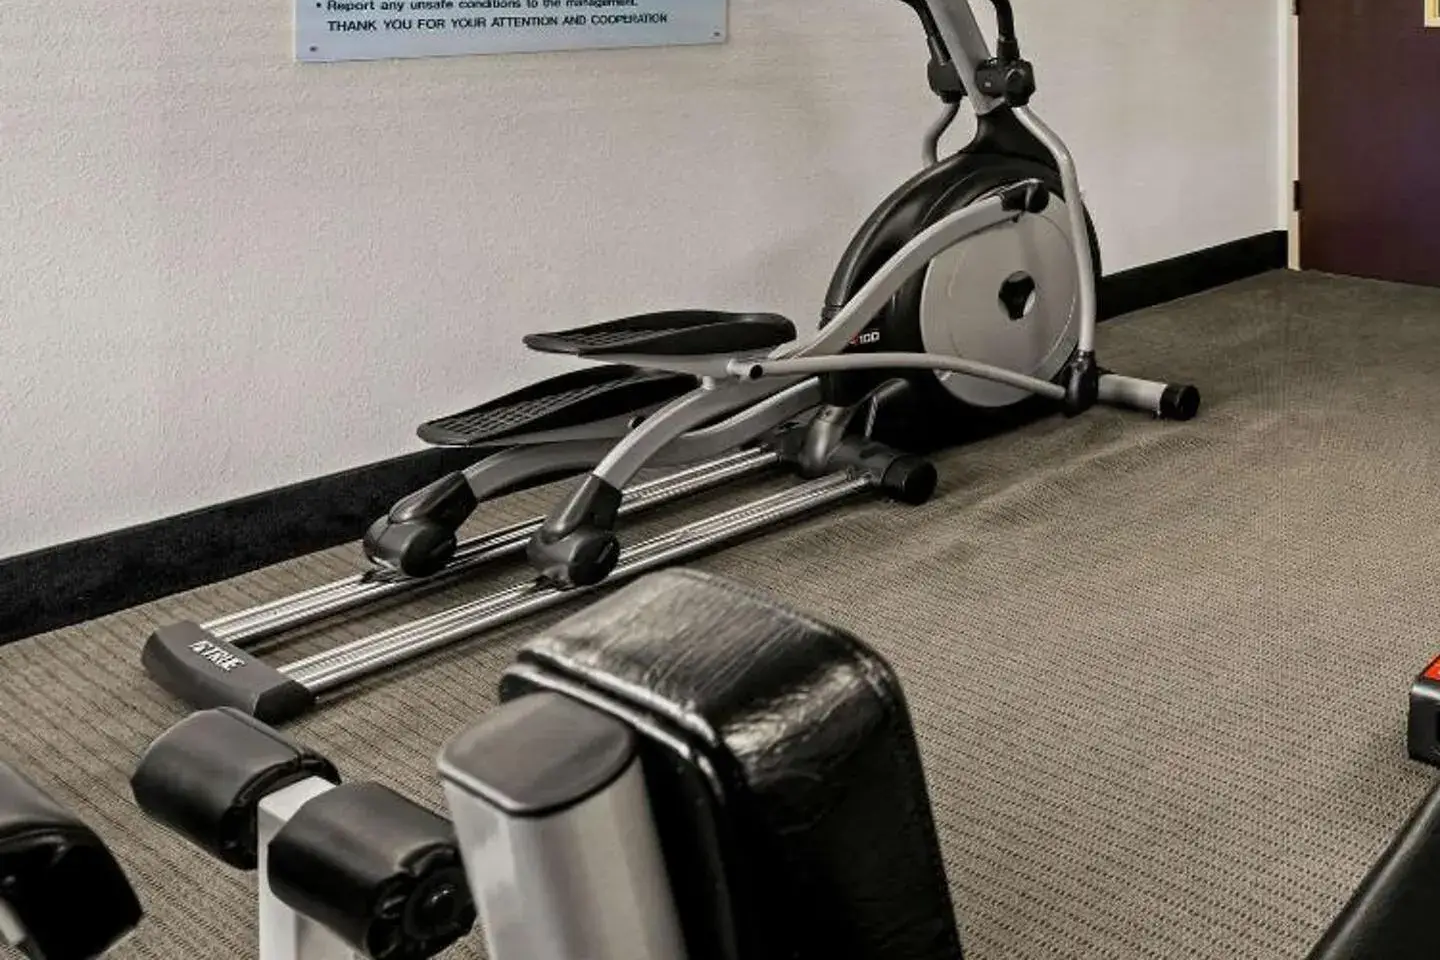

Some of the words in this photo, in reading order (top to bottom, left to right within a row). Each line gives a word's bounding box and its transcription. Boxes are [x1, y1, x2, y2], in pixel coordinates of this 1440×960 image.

[327, 0, 375, 11] Report
[380, 1, 404, 12] any
[410, 0, 453, 10] unsafe
[458, 0, 521, 10] conditions
[526, 0, 538, 9] to
[327, 20, 377, 32] THANK
[383, 19, 412, 30] YOU
[417, 18, 445, 30] FOR
[451, 17, 487, 28] YOUR
[490, 15, 558, 28] ATTENTION
[562, 14, 586, 25] AND
